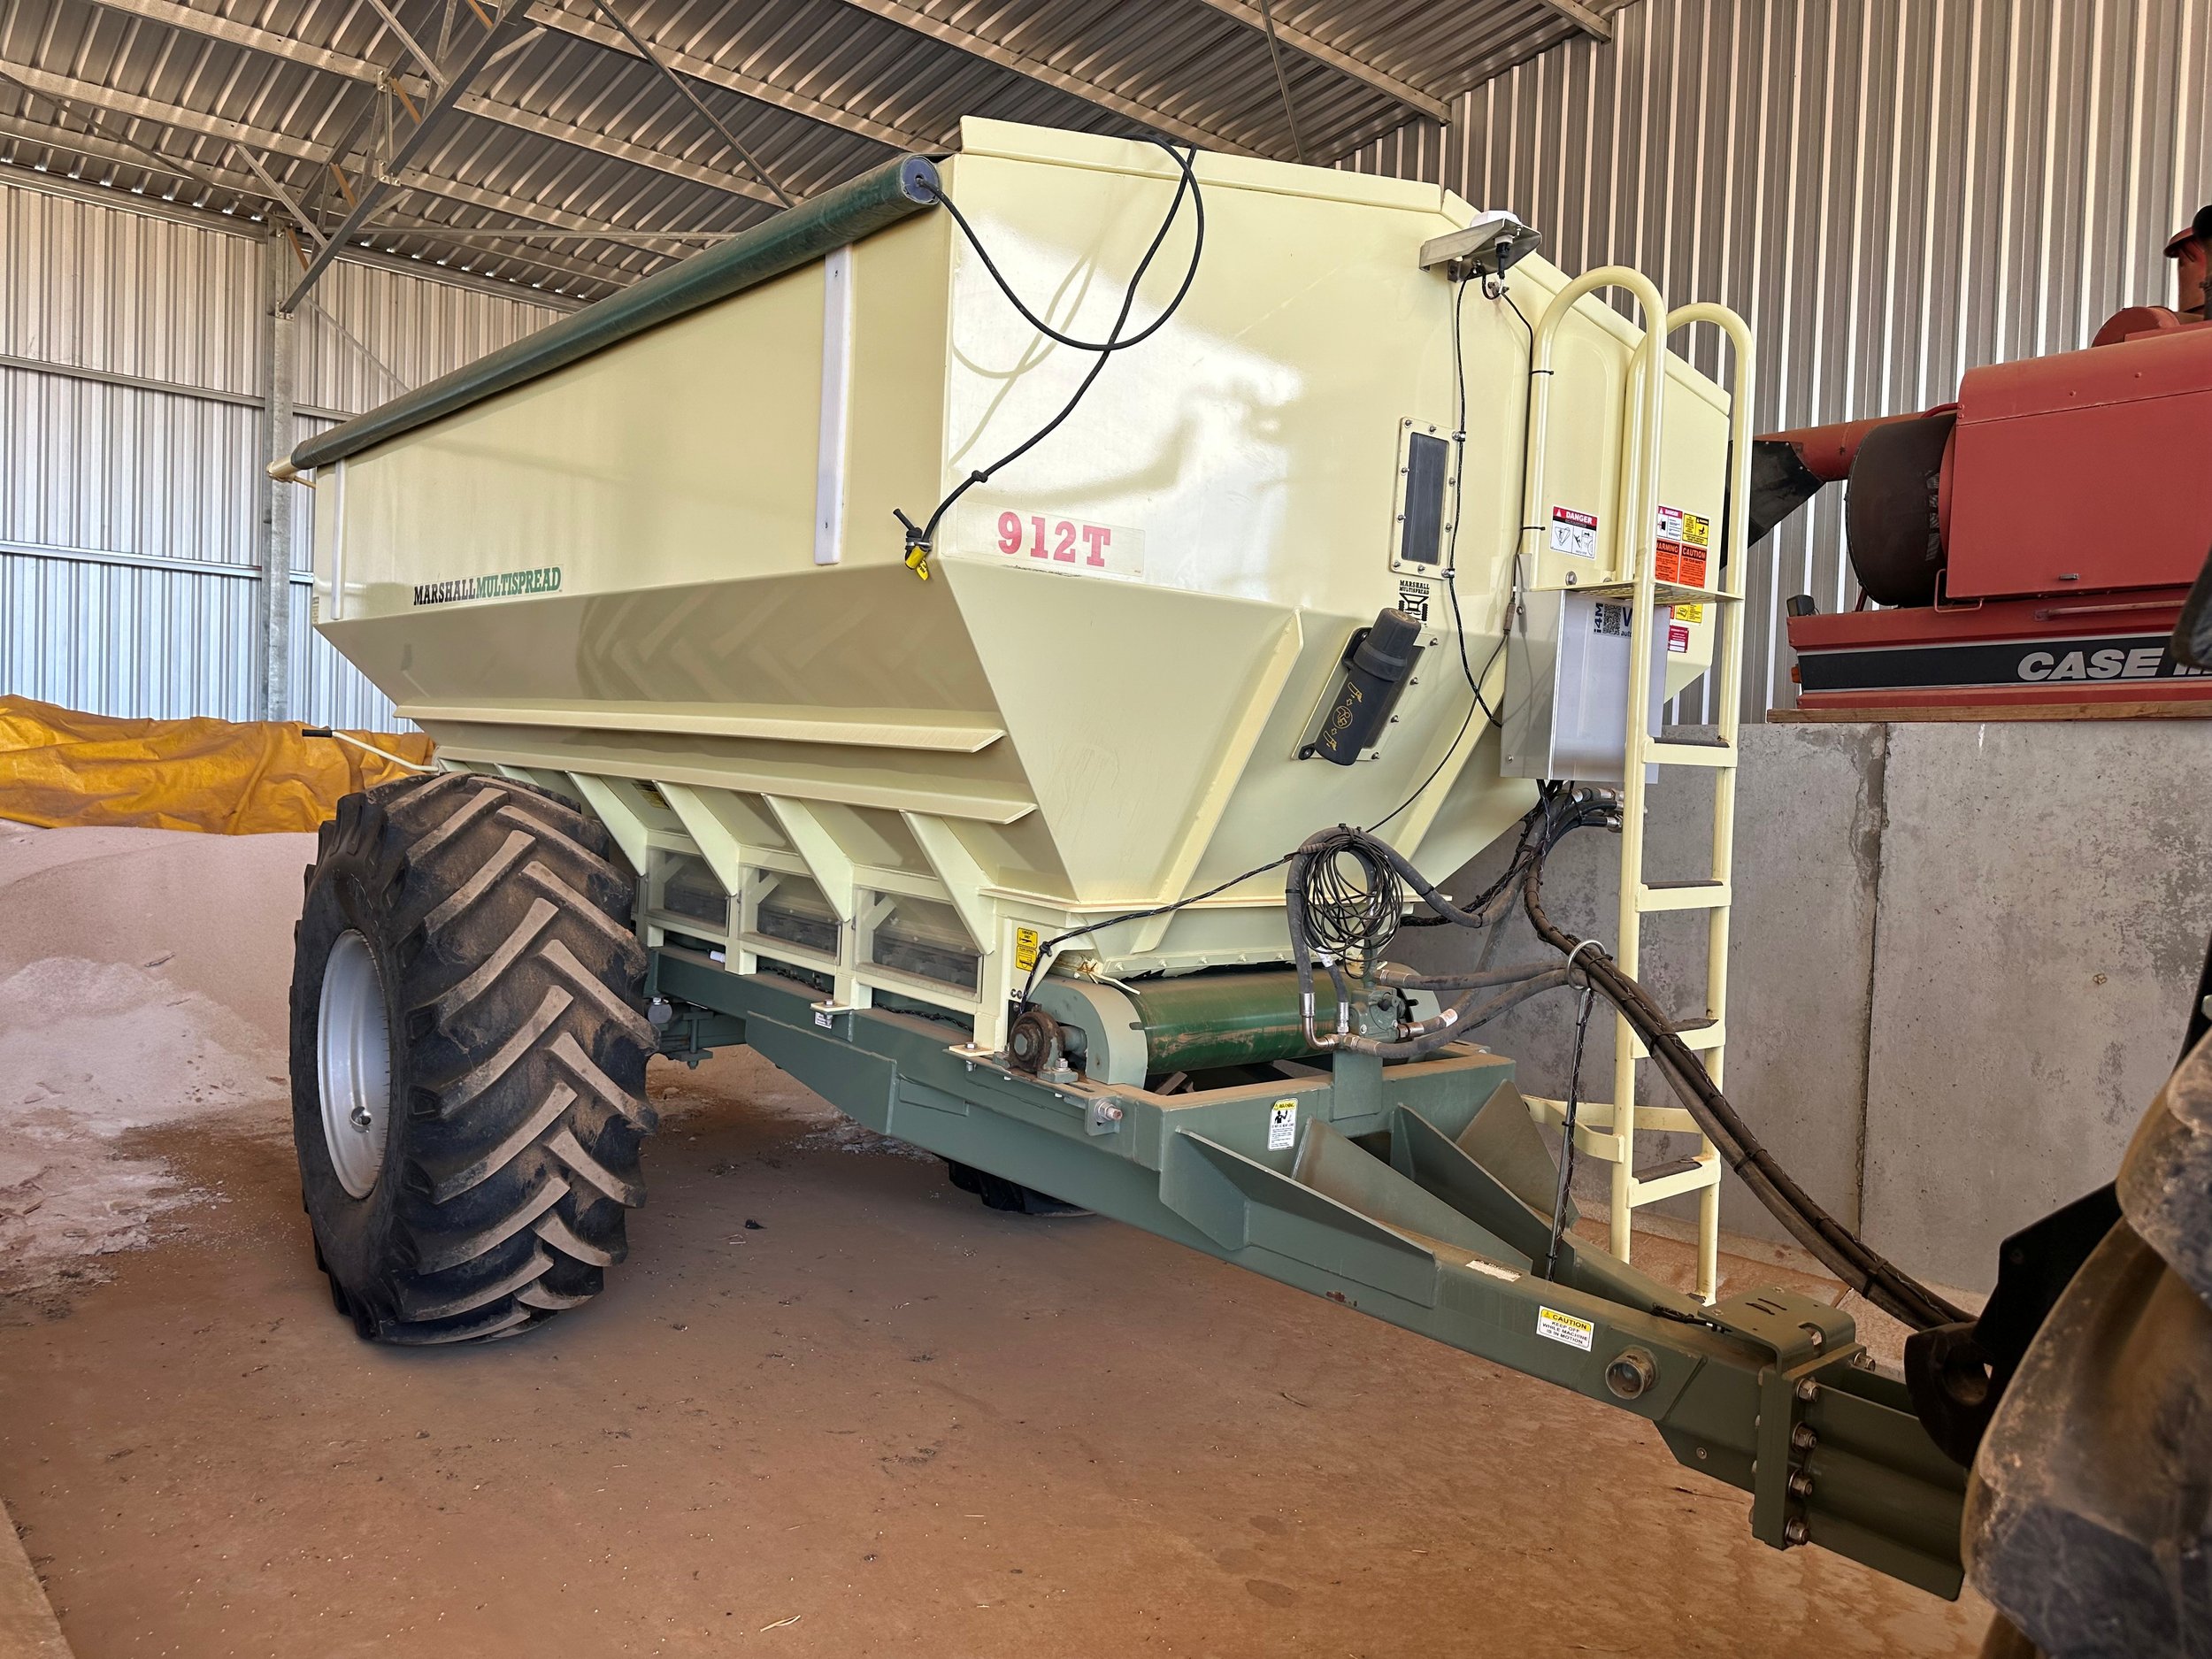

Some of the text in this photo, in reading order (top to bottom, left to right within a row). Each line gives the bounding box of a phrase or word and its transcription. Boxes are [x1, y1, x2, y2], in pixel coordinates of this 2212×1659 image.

[1565, 511, 1593, 525] DANGER
[998, 511, 1110, 567] 912T
[1682, 547, 1706, 559] CAUTION
[1400, 580, 1430, 590] MARSHALL
[2017, 647, 2165, 681] CASE
[1553, 1314, 1586, 1330] CAUTION
[1542, 1323, 1587, 1340] WHILE MACHINE
[1560, 1333, 1583, 1344] MOTION
